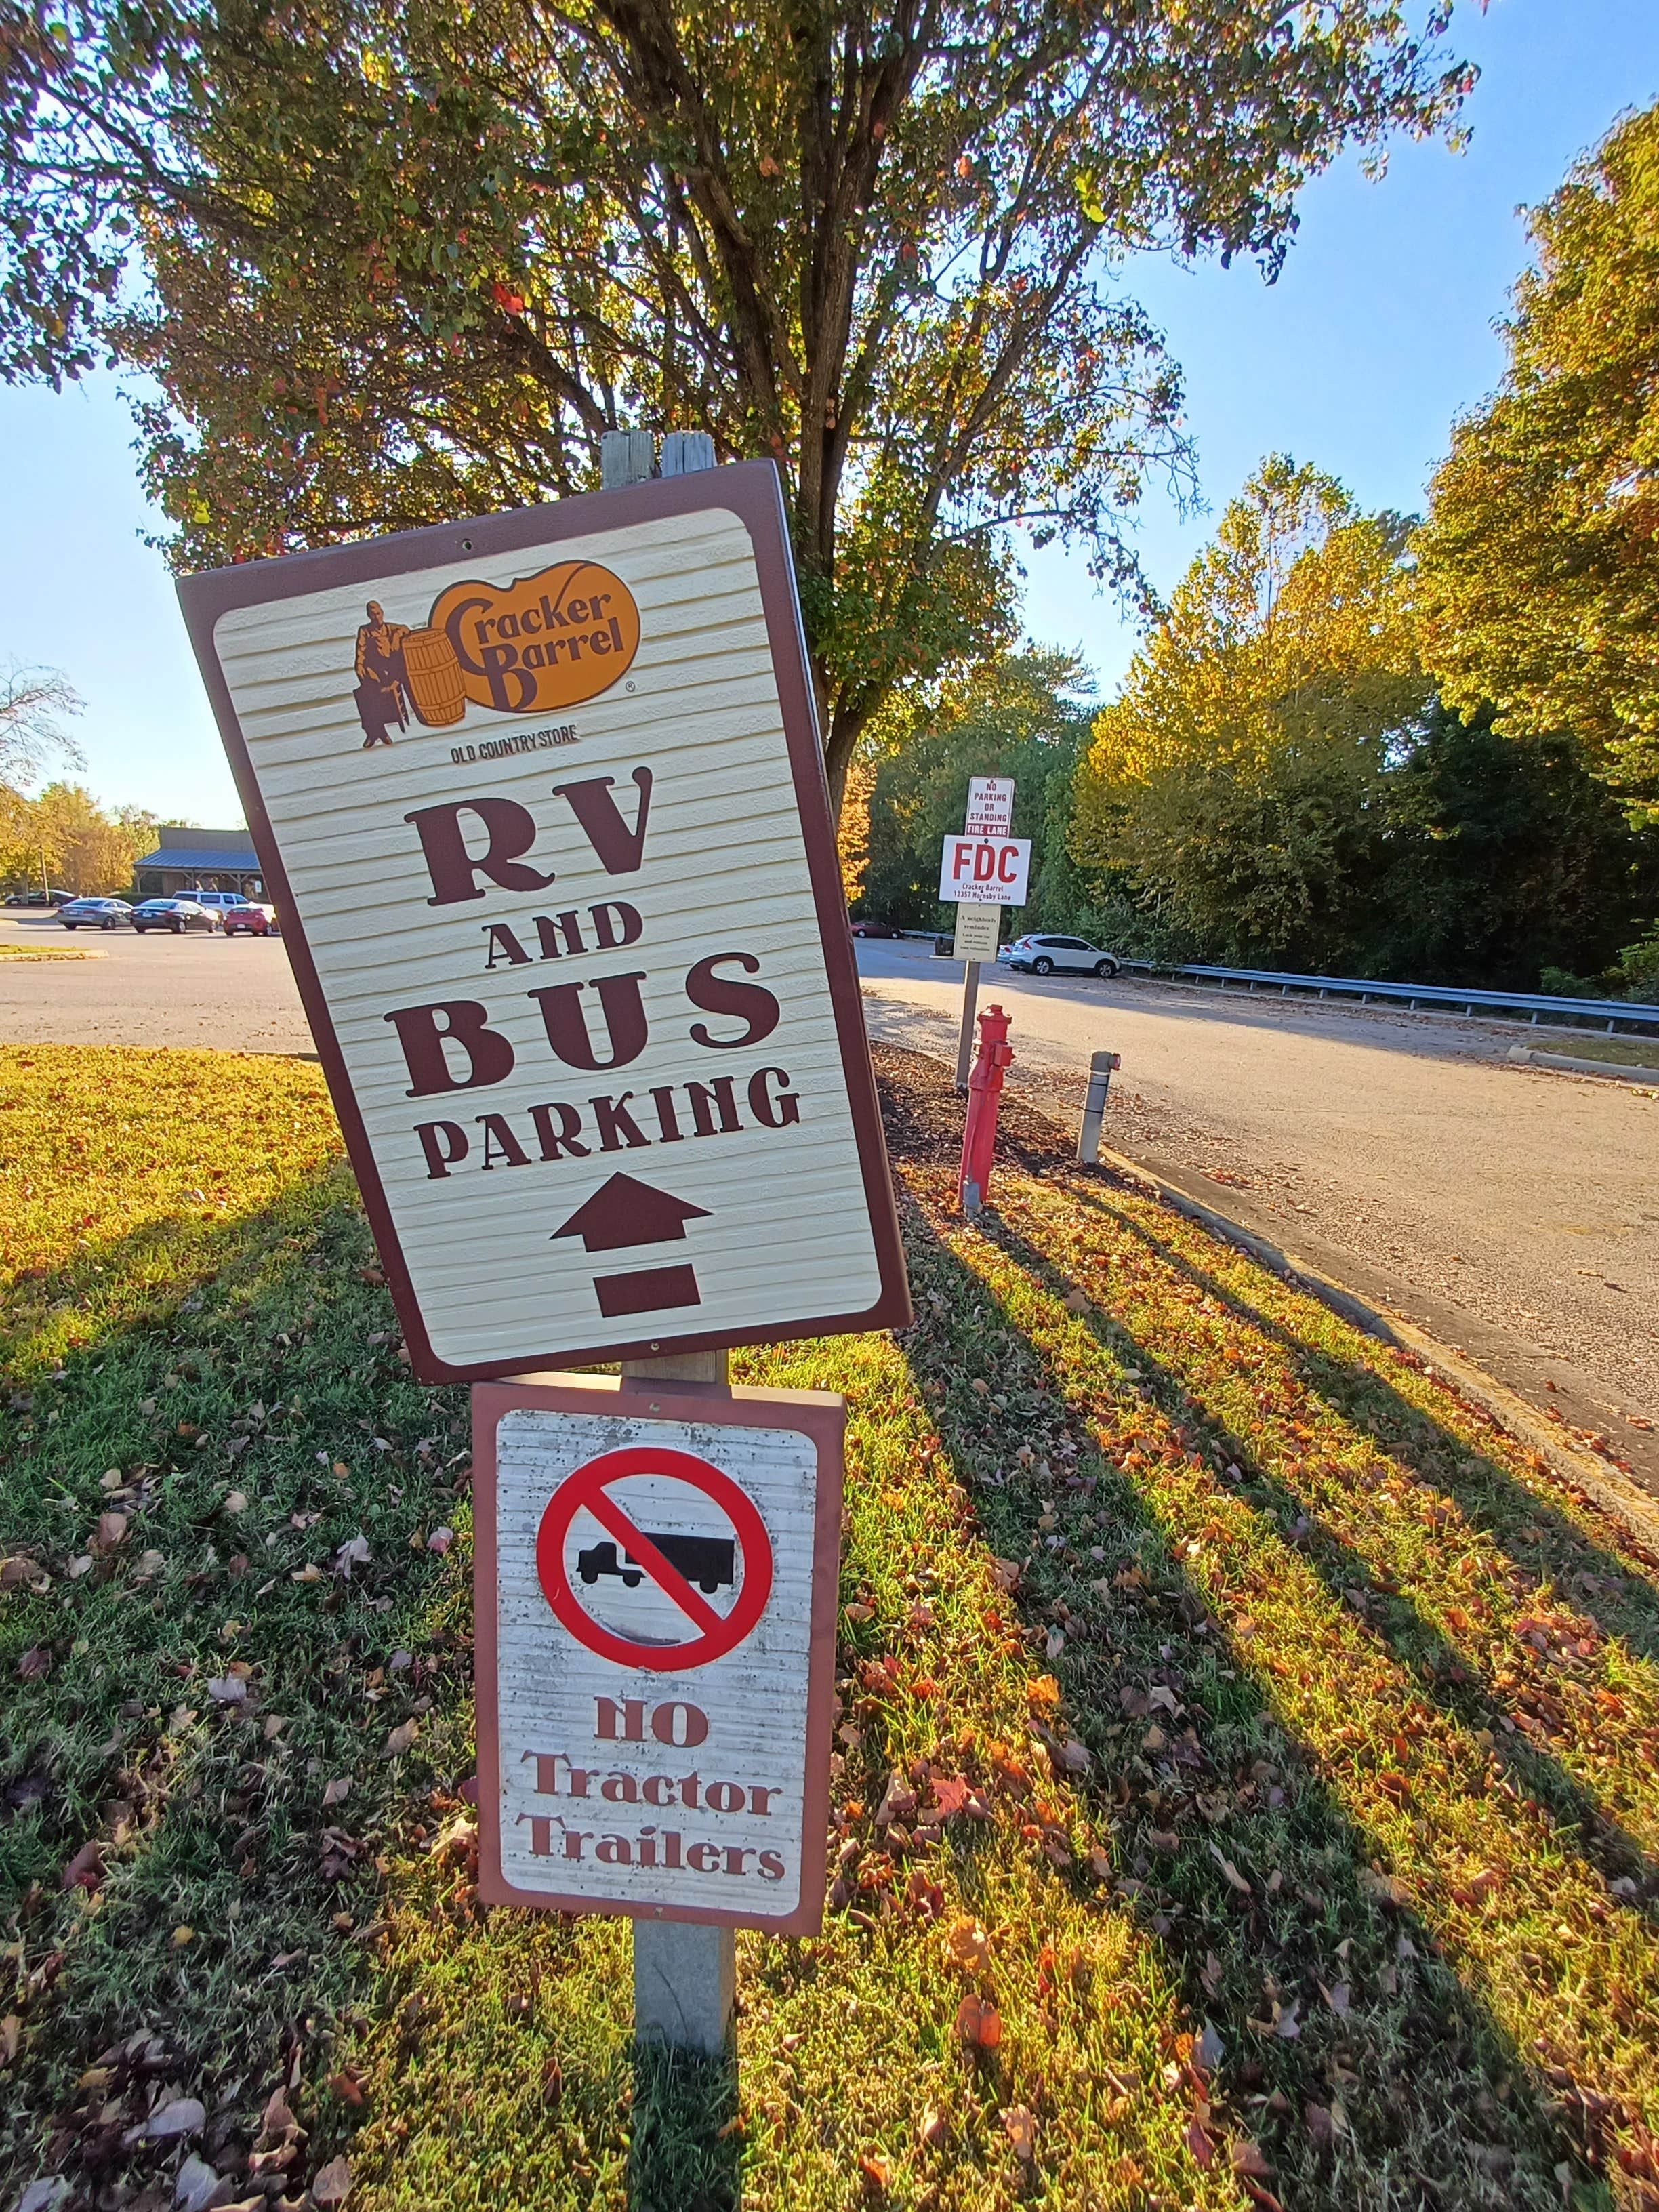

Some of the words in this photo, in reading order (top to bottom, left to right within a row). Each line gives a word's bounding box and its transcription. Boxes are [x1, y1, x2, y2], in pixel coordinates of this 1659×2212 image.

[445, 593, 612, 676] Cracker
[478, 617, 625, 712] Barrel
[450, 745, 476, 764] OLD
[478, 732, 537, 760] COUNTRY
[537, 724, 579, 747] STORE
[974, 792, 1007, 802] PARKING
[984, 803, 995, 811] OR
[986, 783, 997, 791] NO
[403, 766, 653, 906] RV
[967, 825, 984, 834] FIRE
[987, 825, 1008, 836] LANE
[970, 813, 1007, 822] STANDING
[953, 843, 1019, 884] FDC
[954, 890, 971, 898] 12357
[972, 892, 996, 901] Hornsby
[962, 883, 984, 891] Cracker
[481, 901, 644, 970] AND
[383, 951, 781, 1098] BUS
[413, 1066, 801, 1180] PARKING
[593, 1696, 709, 1748] NO
[520, 1748, 783, 1816] Tractor
[514, 1812, 786, 1881] Trailers
